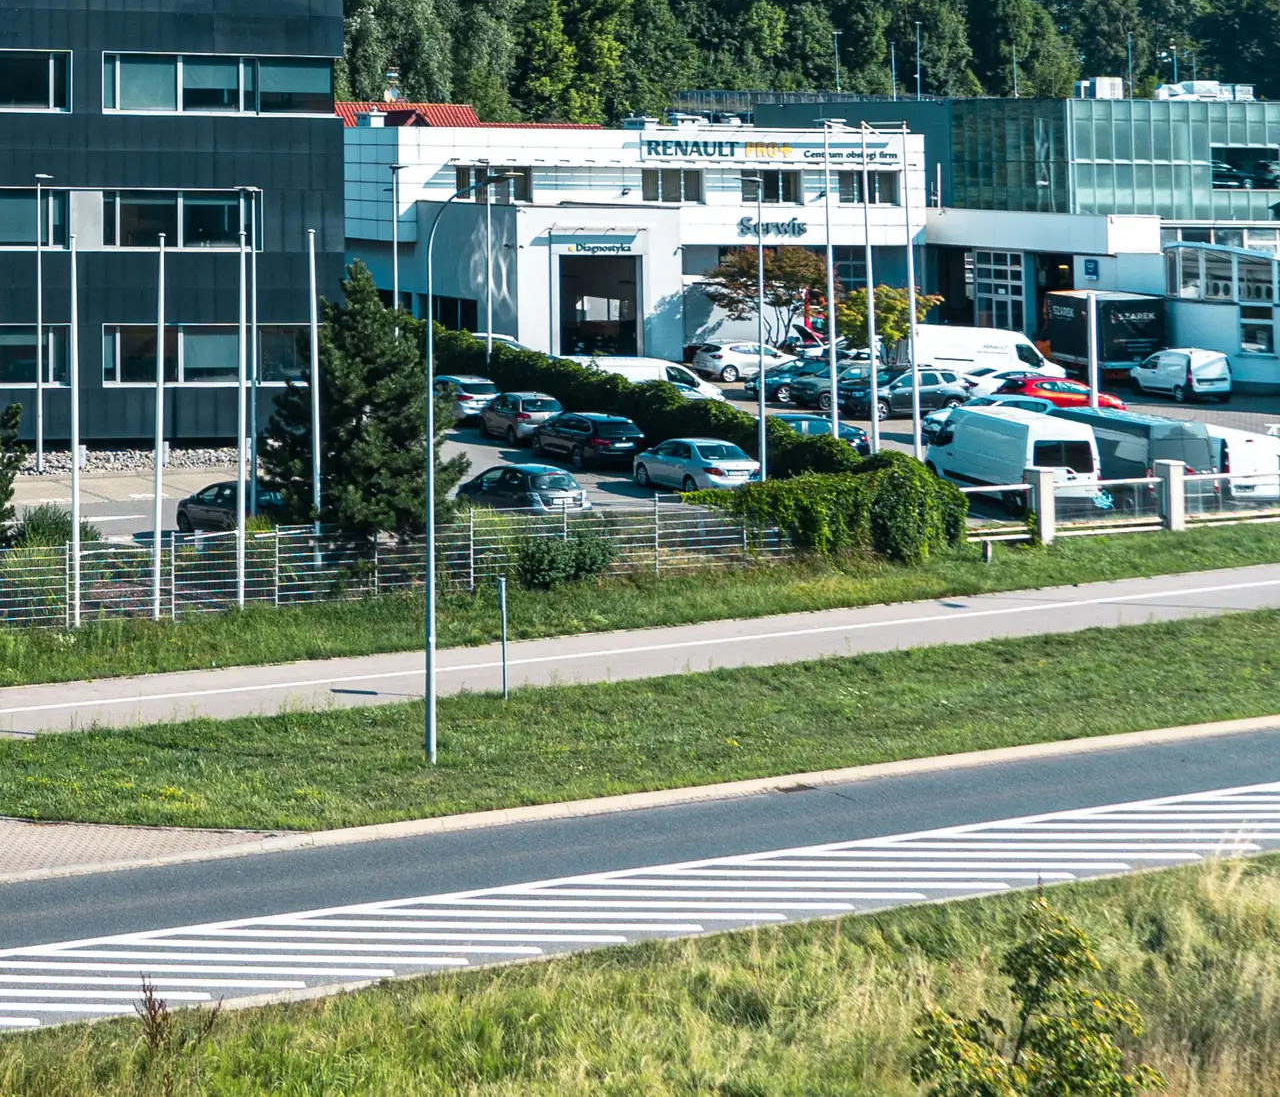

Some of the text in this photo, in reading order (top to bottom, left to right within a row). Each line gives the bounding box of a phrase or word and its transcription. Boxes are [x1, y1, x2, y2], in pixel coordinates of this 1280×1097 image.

[646, 140, 739, 158] RENAULT
[739, 216, 808, 238] Serwis
[575, 243, 632, 254] Diagnostyka
